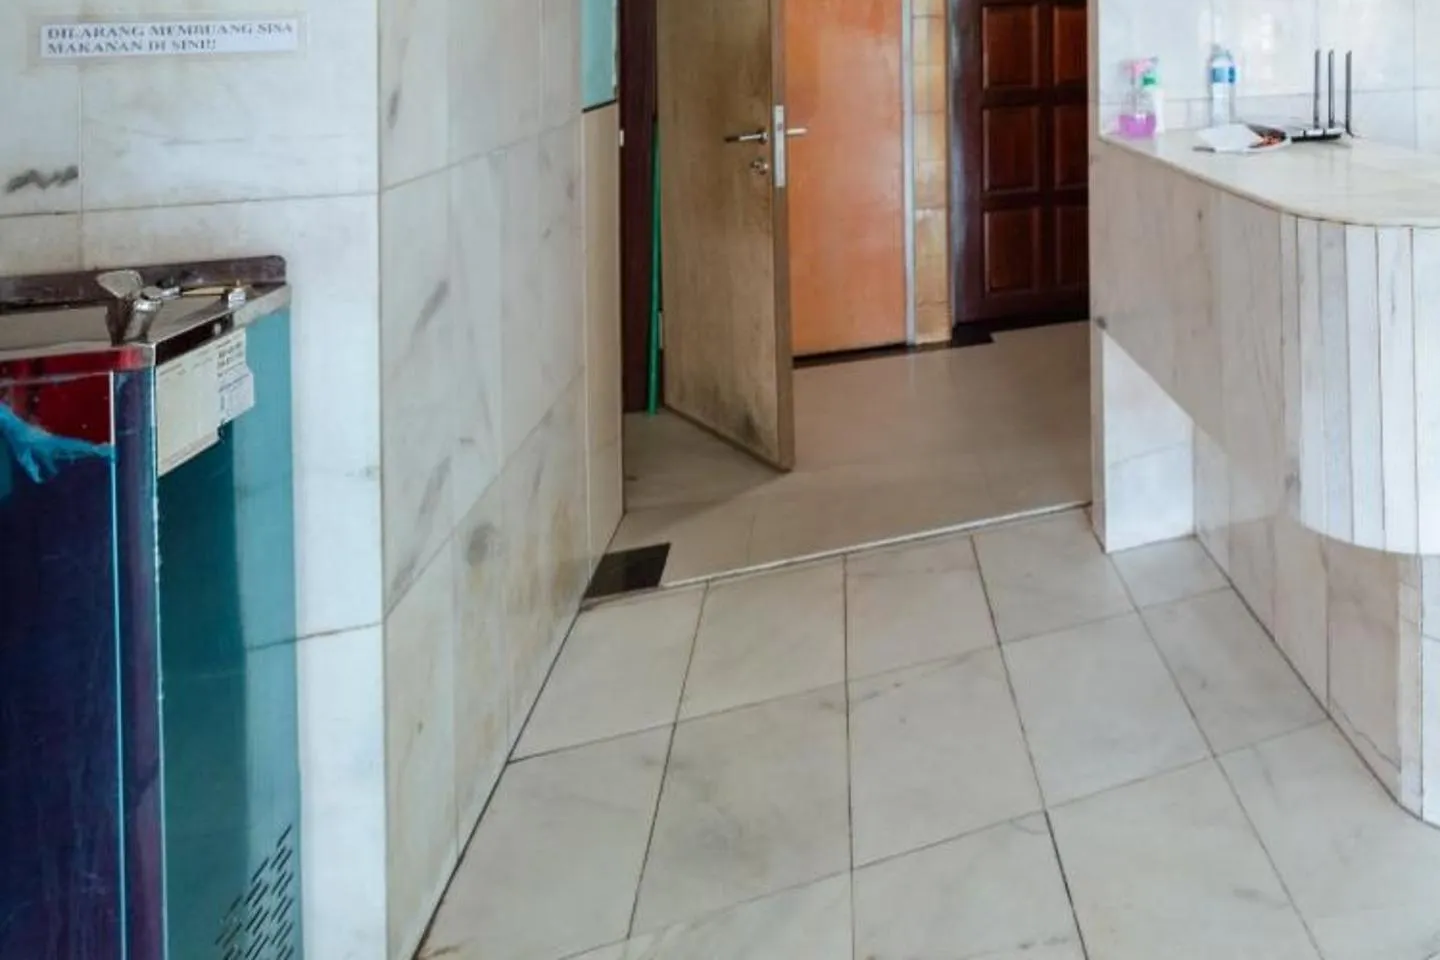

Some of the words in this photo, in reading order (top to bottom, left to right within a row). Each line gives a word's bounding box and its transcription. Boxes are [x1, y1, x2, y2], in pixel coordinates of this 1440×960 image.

[47, 25, 145, 40] DILARANG
[150, 23, 252, 39] MEMBUANG
[257, 22, 294, 35] SISA
[47, 40, 142, 55] MAKANAN
[149, 40, 168, 52] DI
